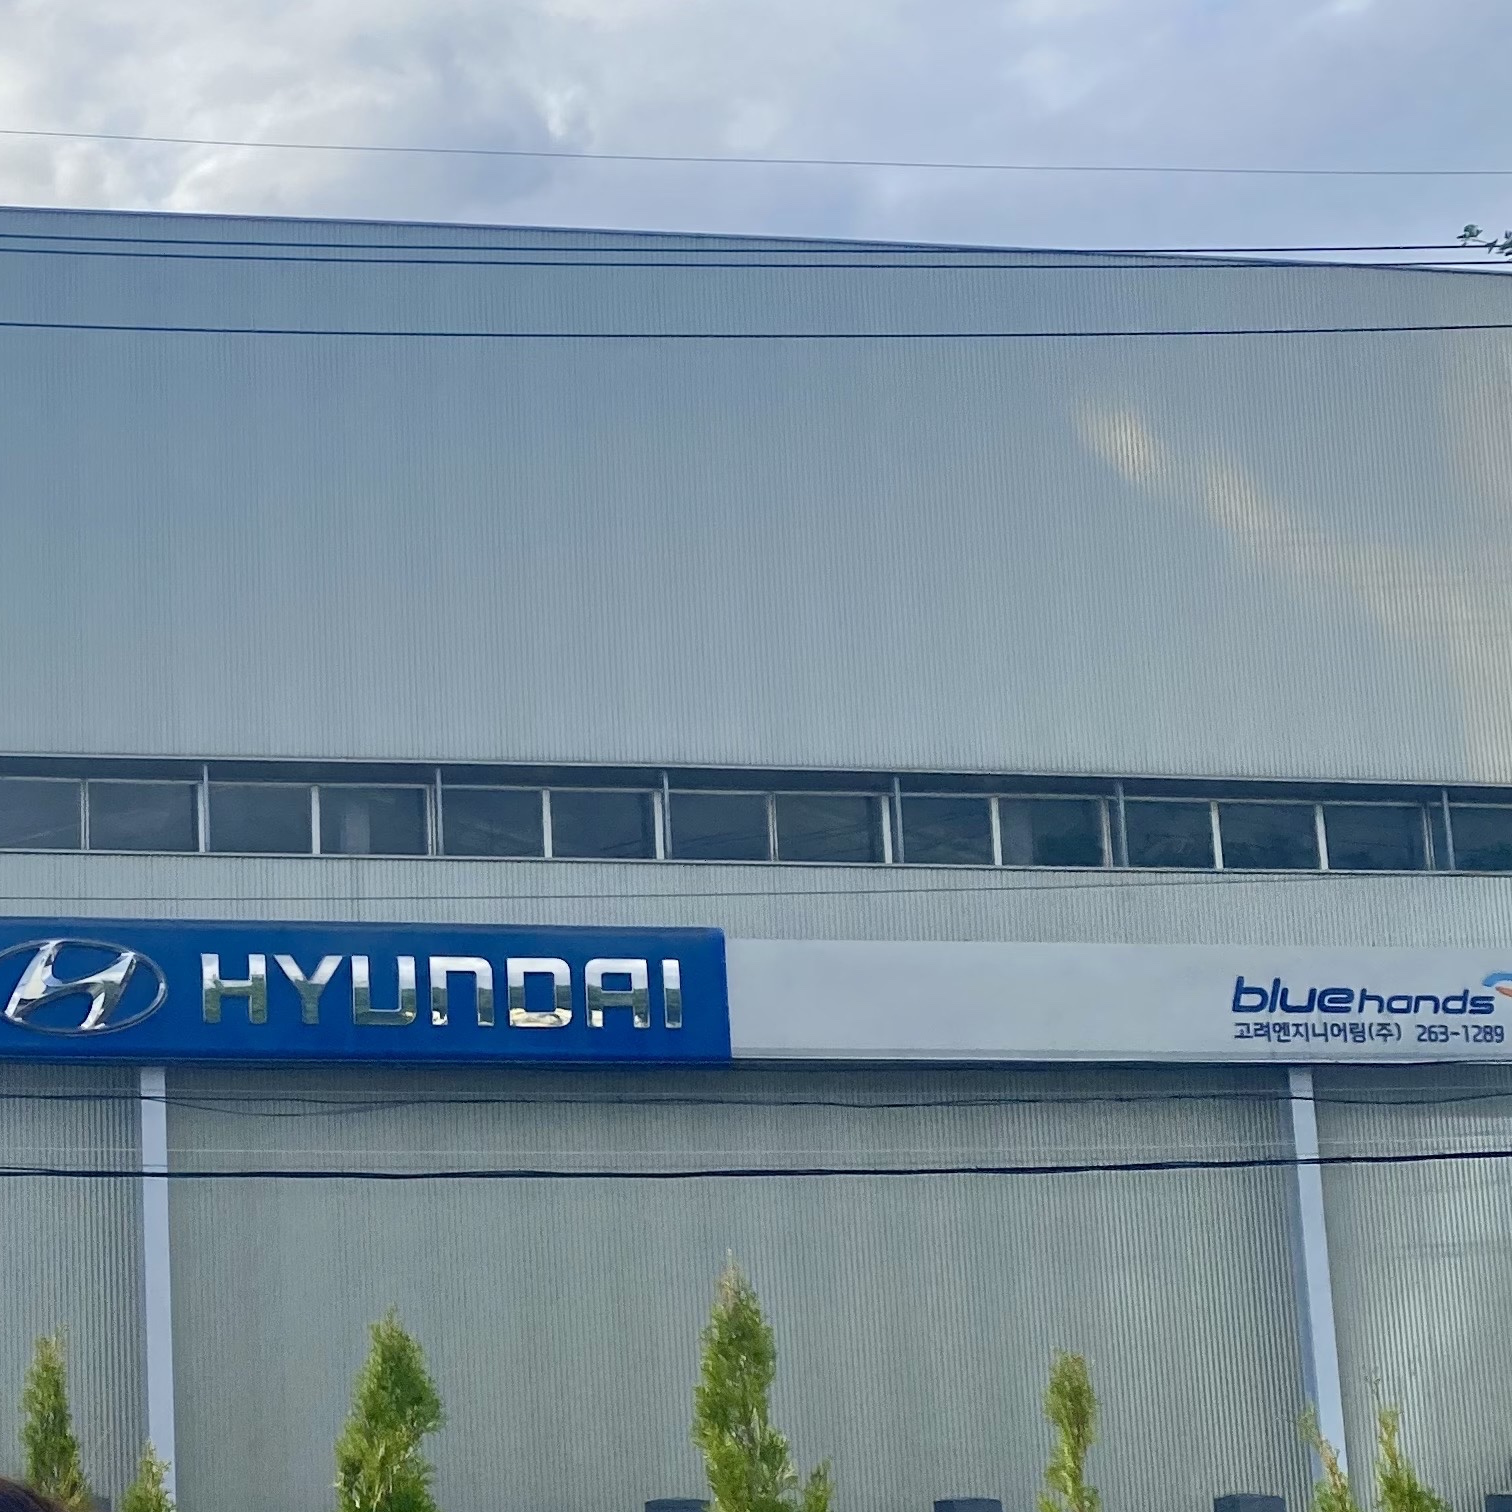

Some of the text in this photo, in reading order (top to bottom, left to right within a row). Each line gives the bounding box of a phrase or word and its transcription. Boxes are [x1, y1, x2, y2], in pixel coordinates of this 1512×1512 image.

[201, 952, 683, 1029] HYUNDAI
[1231, 975, 1496, 1015] bluehands
[1415, 1024, 1505, 1043] 263-1289
